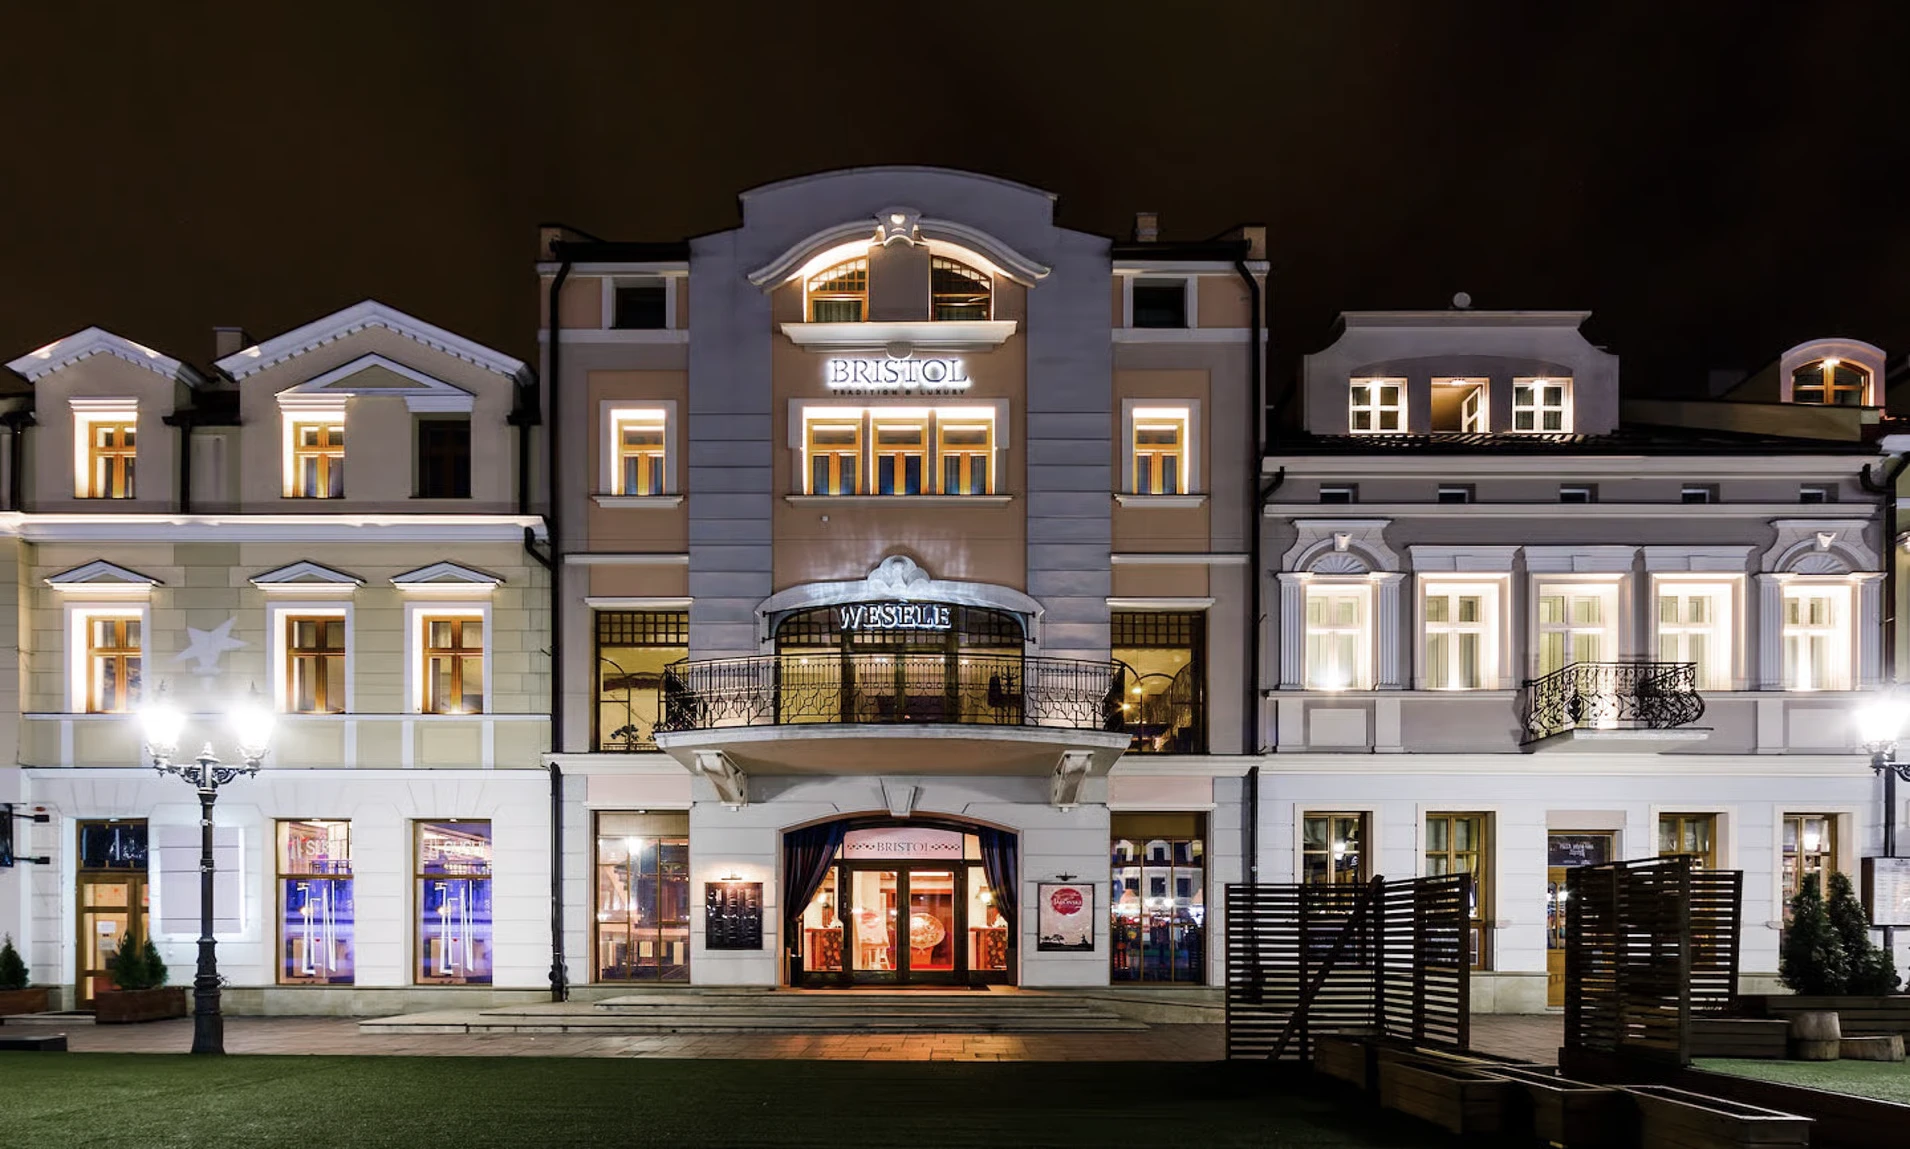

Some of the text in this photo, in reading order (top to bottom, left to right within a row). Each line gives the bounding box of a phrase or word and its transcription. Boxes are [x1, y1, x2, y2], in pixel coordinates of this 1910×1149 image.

[831, 359, 968, 384] BRISTOL
[840, 603, 952, 629] WESELE
[876, 842, 932, 852] BRISTOL
